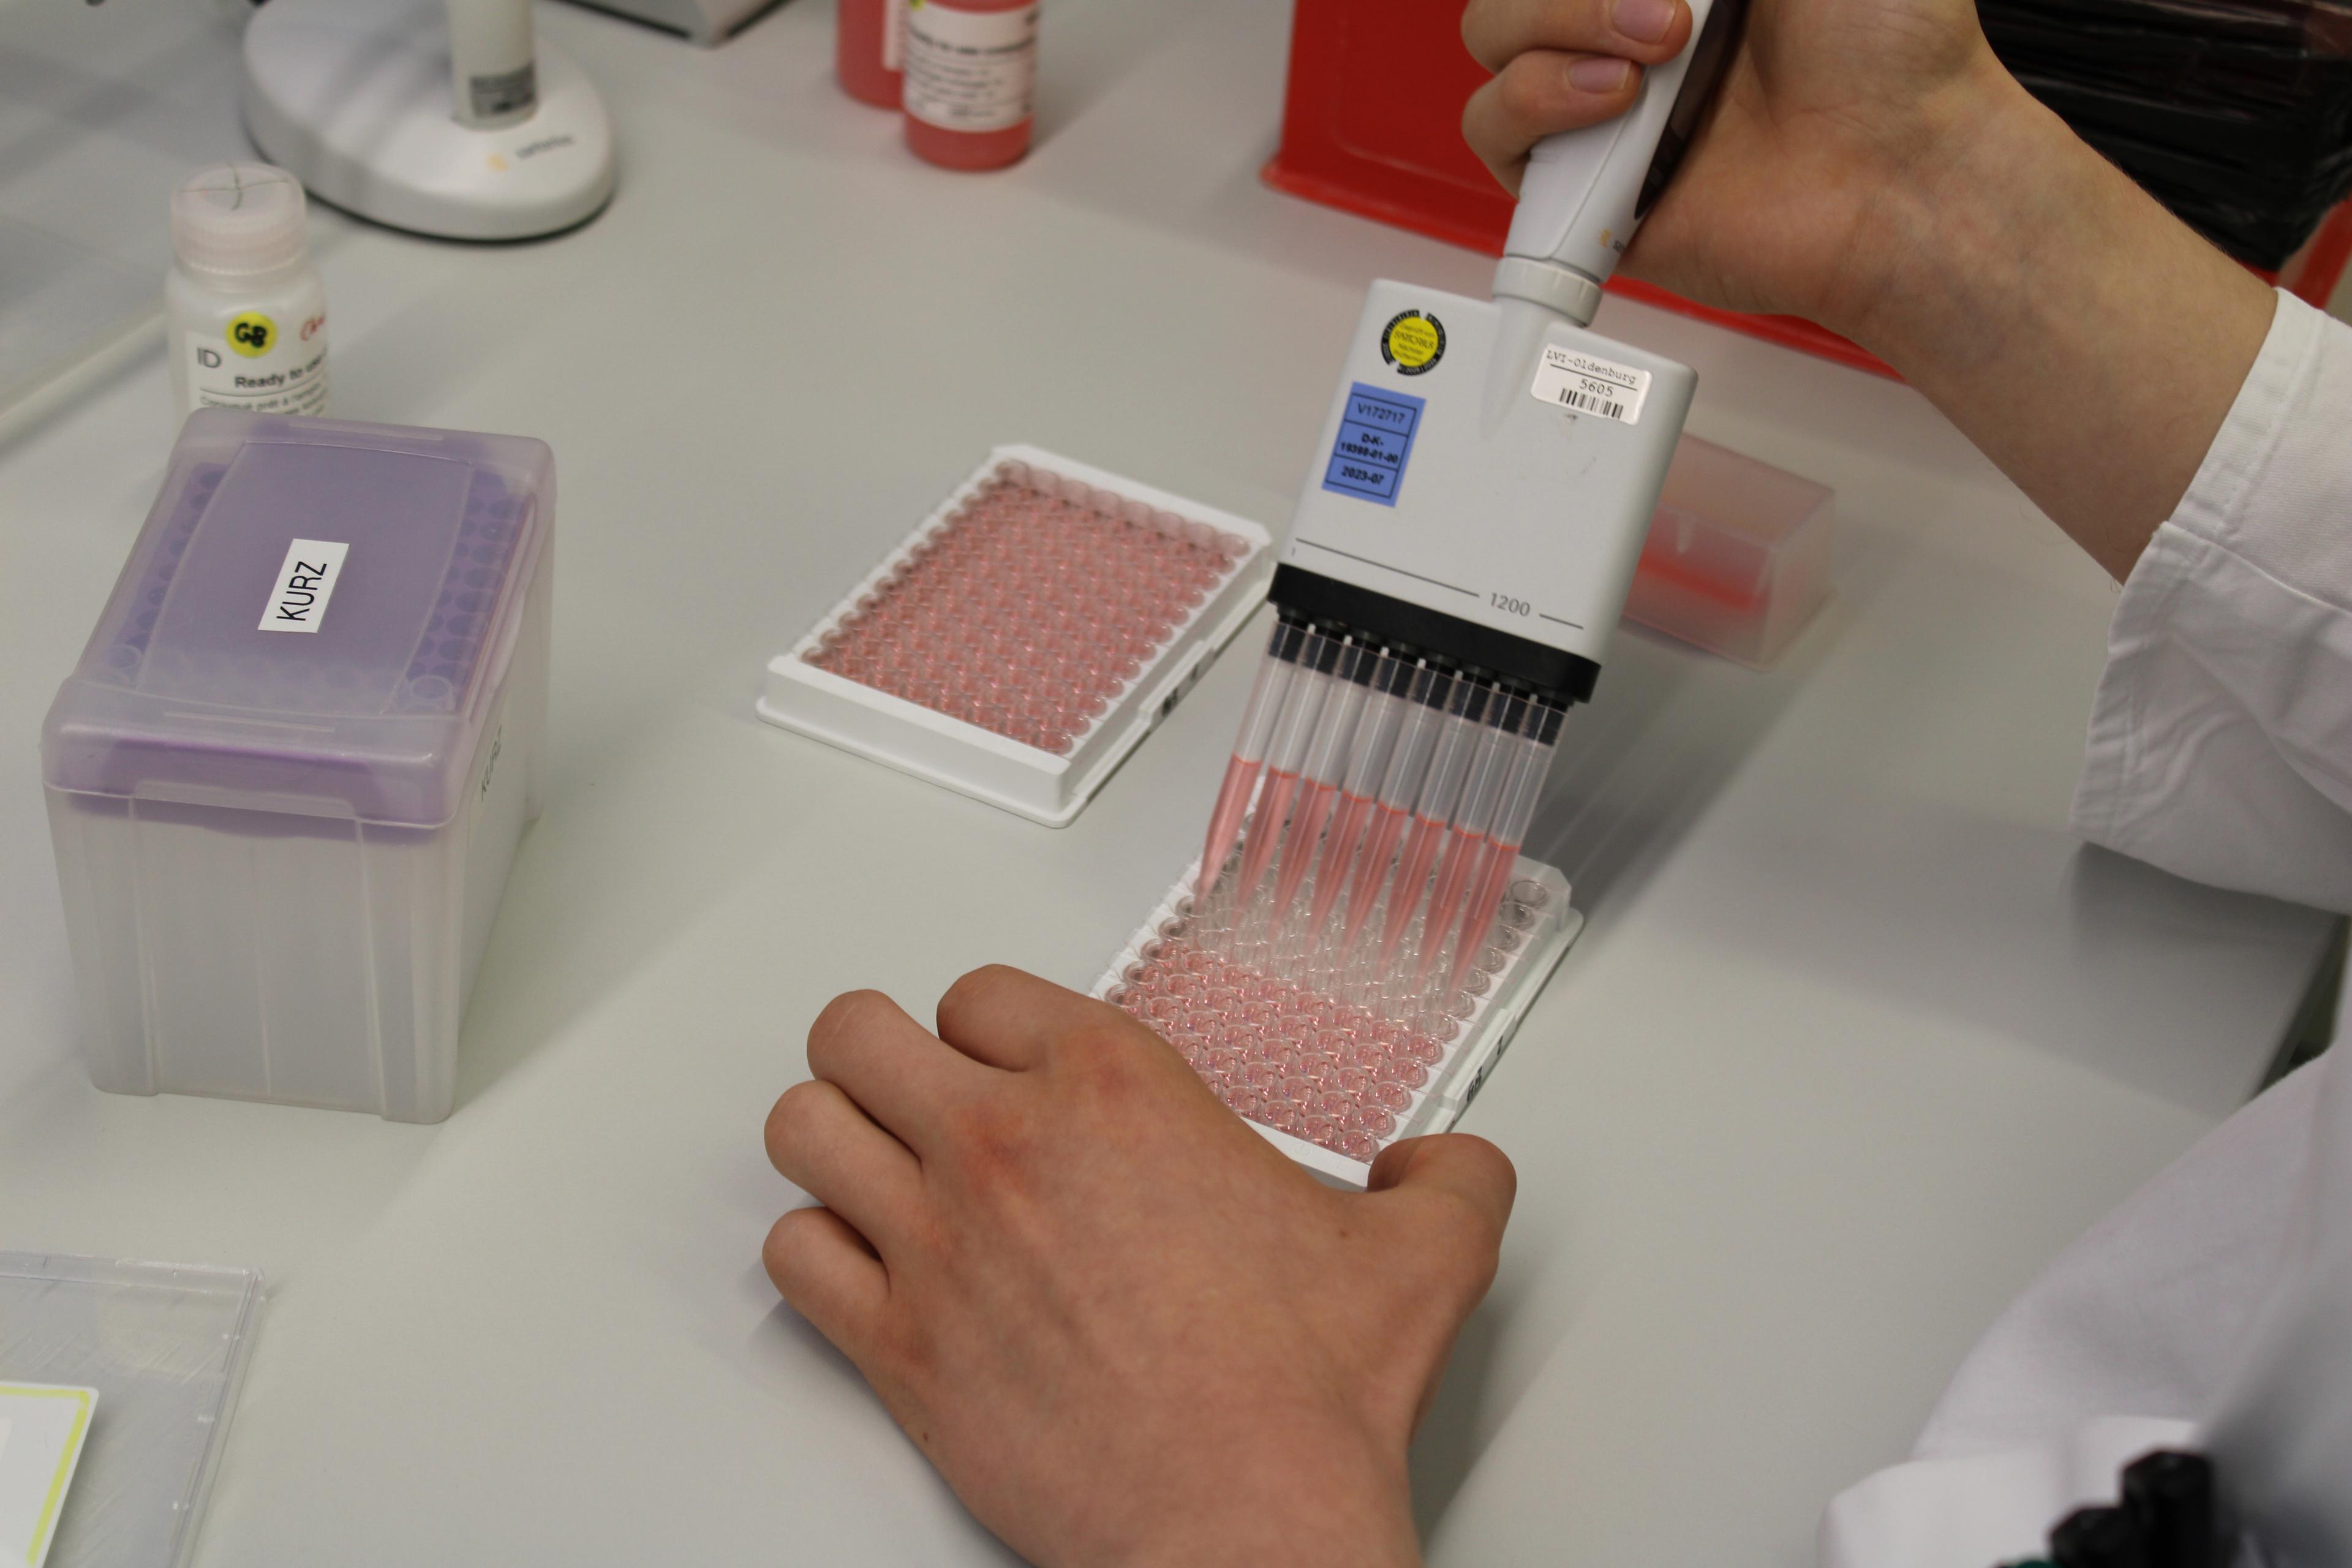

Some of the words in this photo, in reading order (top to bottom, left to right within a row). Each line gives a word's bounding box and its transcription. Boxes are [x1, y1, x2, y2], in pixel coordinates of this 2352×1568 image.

[197, 347, 222, 369] ID
[235, 374, 285, 388] Ready
[1578, 378, 1615, 398] 5605
[1357, 402, 1406, 424] V172717
[1341, 464, 1385, 486] 2023-07
[276, 560, 328, 622] KURZ
[1490, 592, 1531, 617] 1200
